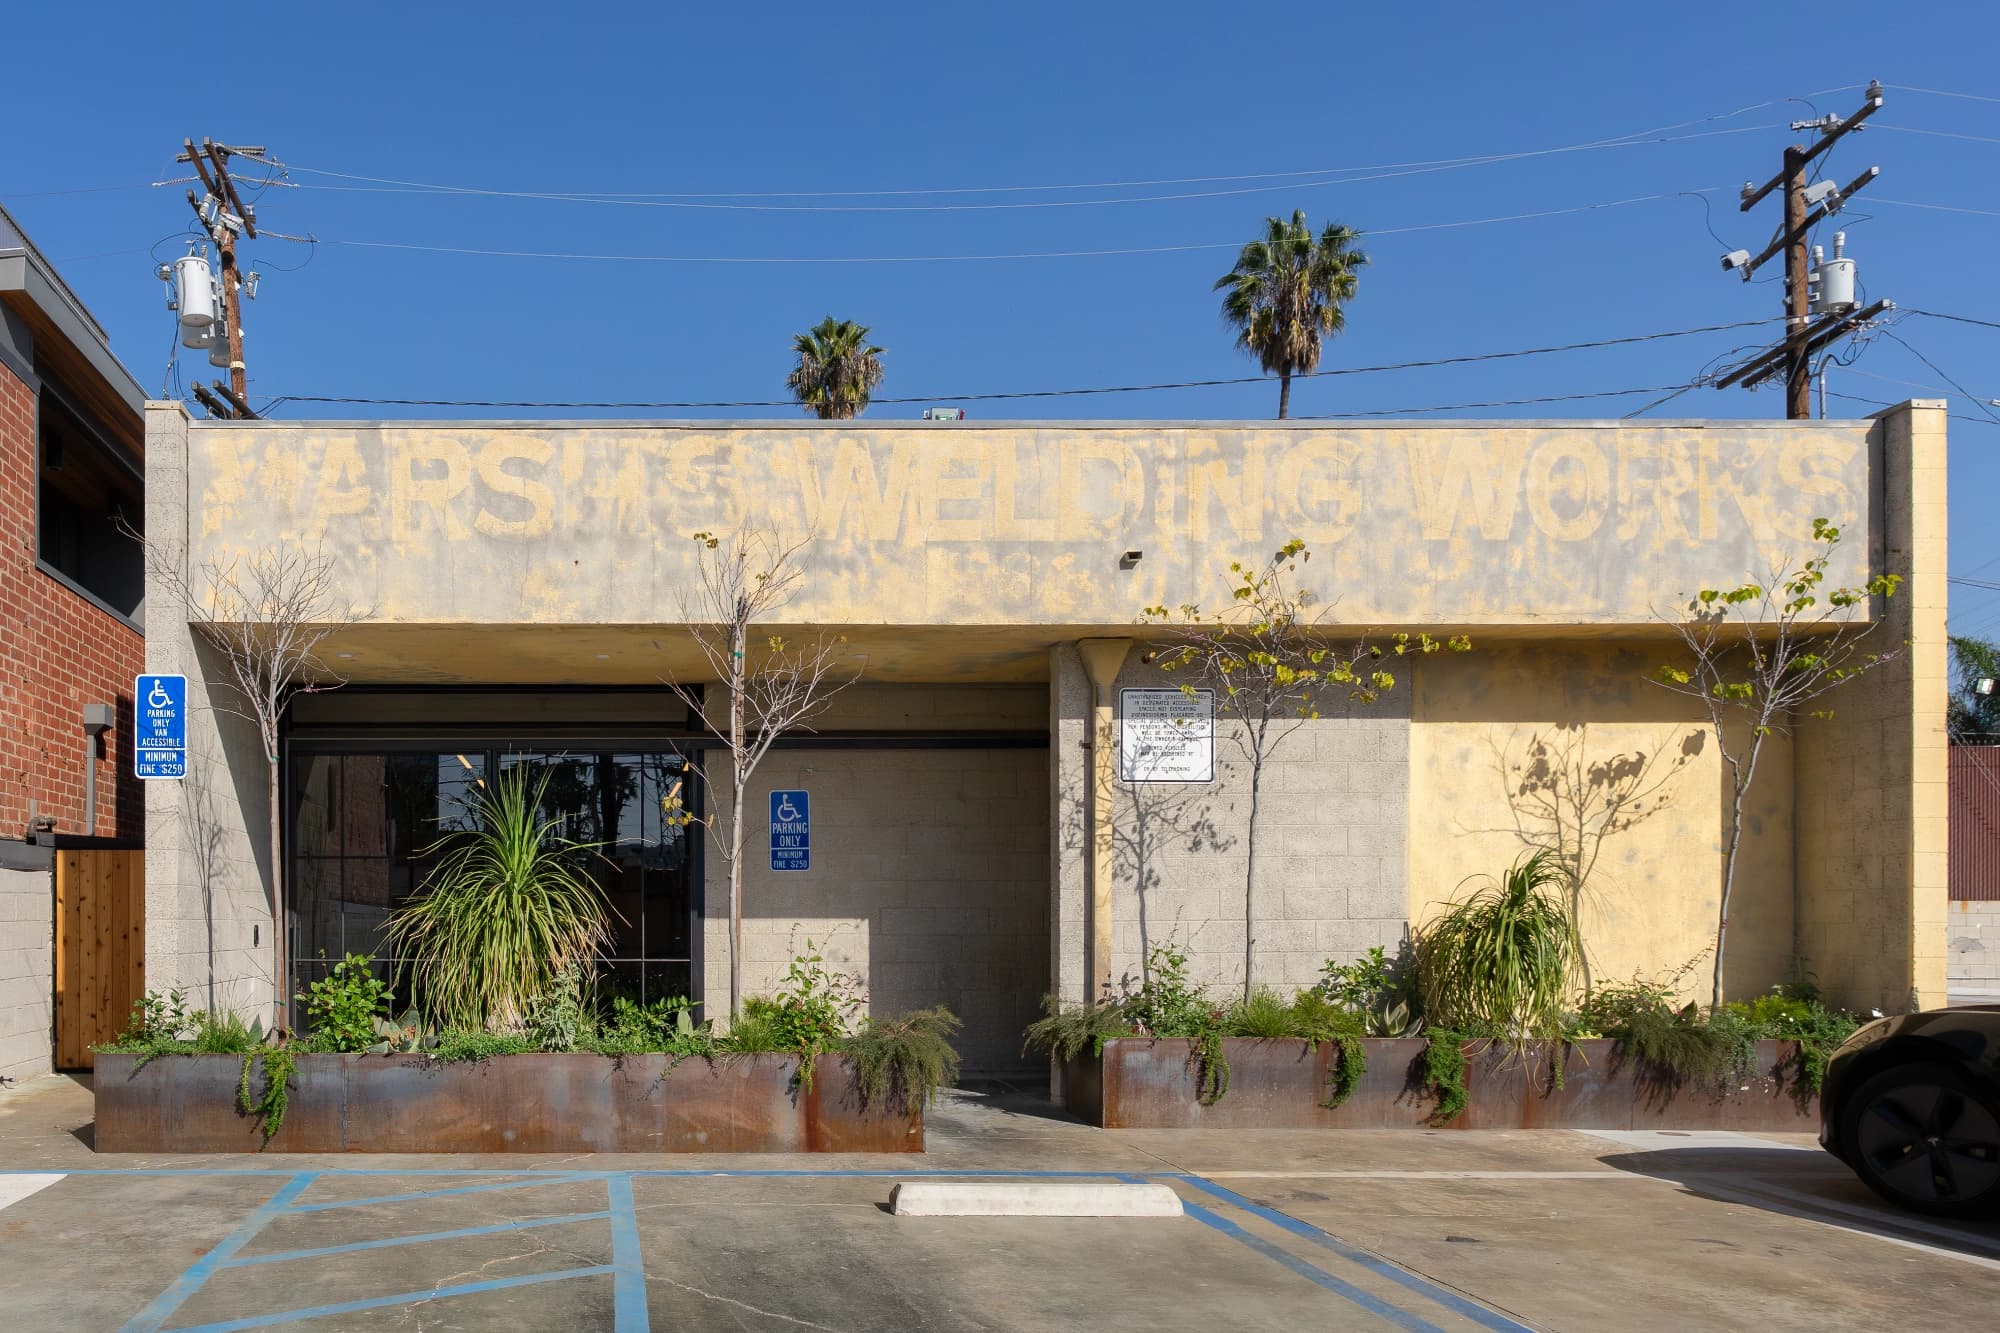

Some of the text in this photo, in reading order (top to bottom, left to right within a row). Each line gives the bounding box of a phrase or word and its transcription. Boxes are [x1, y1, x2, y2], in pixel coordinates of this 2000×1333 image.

[791, 437, 1366, 543] WELDING
[1406, 437, 1860, 543] WORKS
[147, 709, 176, 718] PARKING
[152, 718, 170, 727] ONLY
[154, 728, 168, 737] VAN
[141, 737, 181, 747] ACCESSIBLE
[145, 751, 177, 762] MINIMUM
[139, 763, 183, 775] FINE $250
[772, 822, 808, 834] PARKING
[779, 835, 801, 847] ONLY
